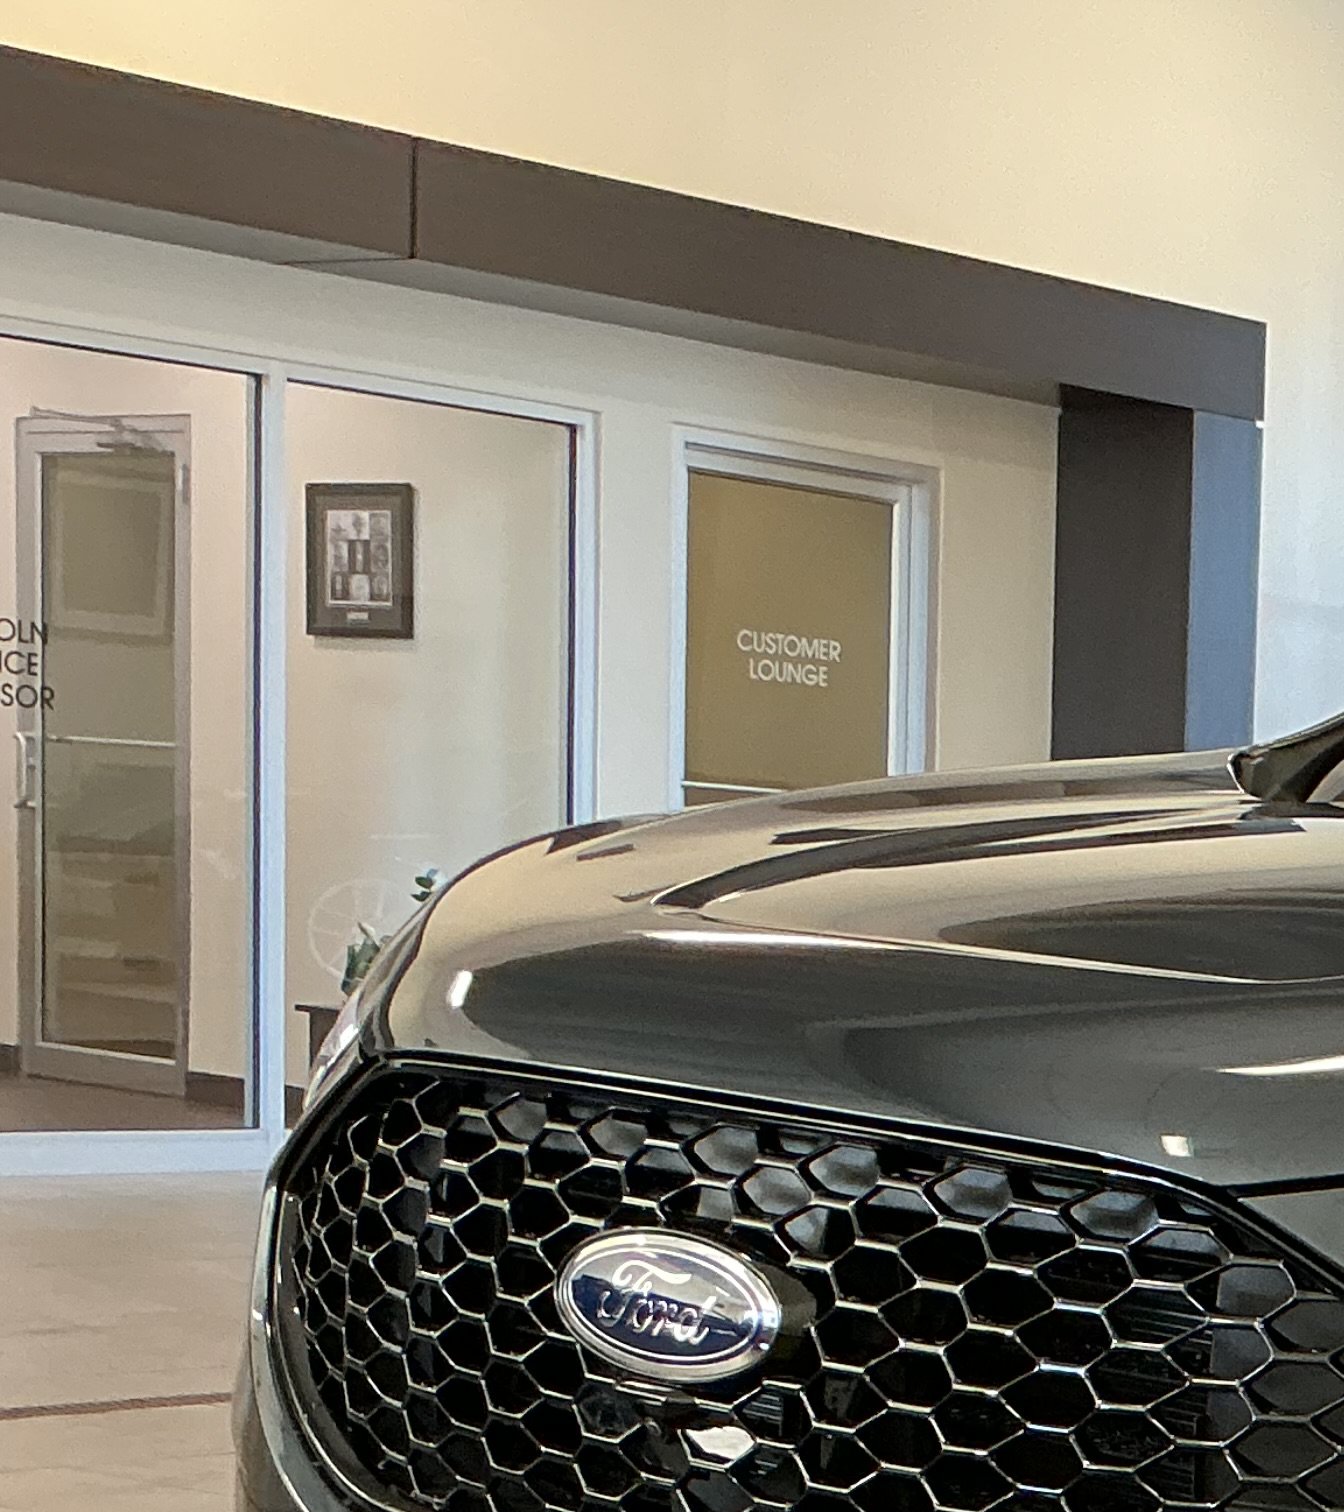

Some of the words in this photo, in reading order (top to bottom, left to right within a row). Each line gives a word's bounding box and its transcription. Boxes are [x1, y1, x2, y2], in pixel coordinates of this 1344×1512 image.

[736, 628, 841, 663] CUSTOMER
[749, 657, 828, 687] LOUNGE
[596, 1258, 718, 1345] Ford
